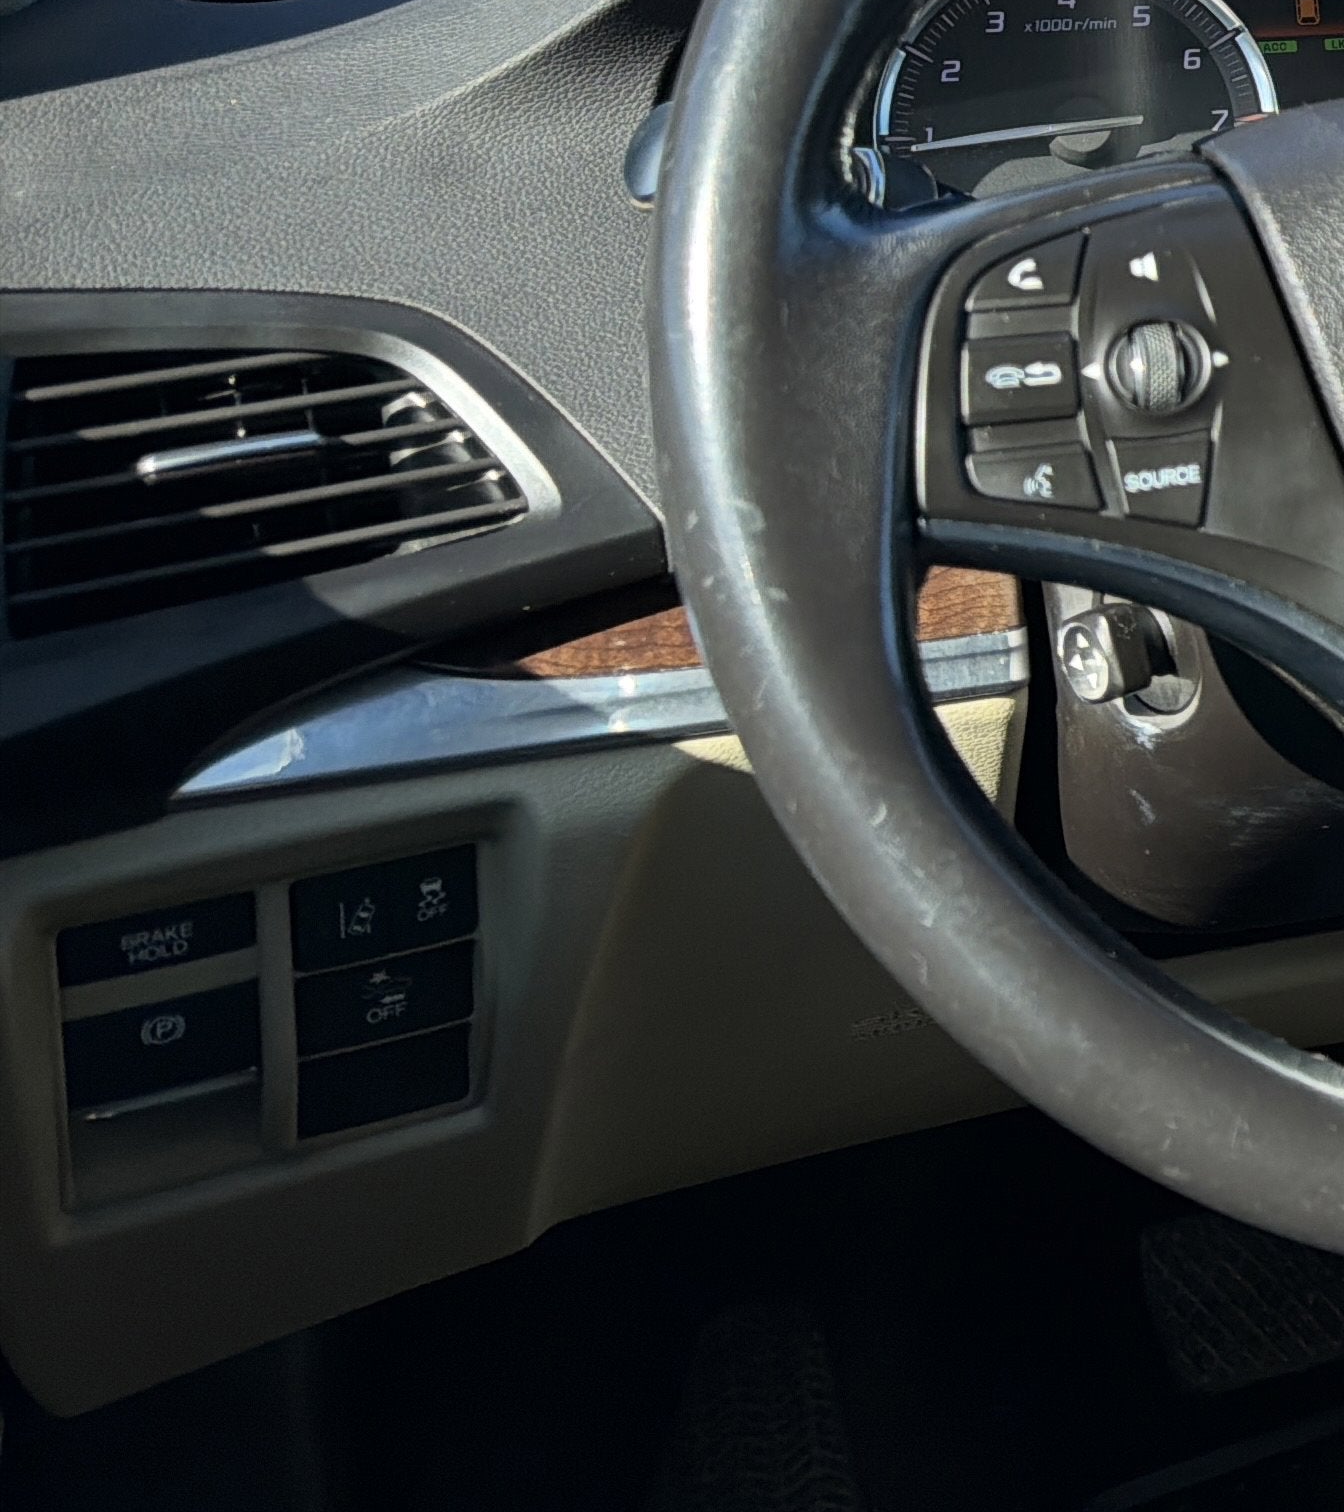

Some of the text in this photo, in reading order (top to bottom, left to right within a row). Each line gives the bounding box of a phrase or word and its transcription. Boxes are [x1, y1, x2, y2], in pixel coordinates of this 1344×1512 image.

[985, 11, 1005, 33] 3
[1133, 5, 1150, 27] 5
[1183, 48, 1201, 70] 6
[940, 60, 961, 82] 2
[1211, 109, 1229, 132] 7
[924, 126, 934, 143] 1
[1123, 463, 1200, 493] SOURCE
[417, 903, 448, 922] OFF
[121, 921, 193, 952] BRAKE
[129, 939, 189, 964] HOLD
[365, 999, 409, 1025] OFF
